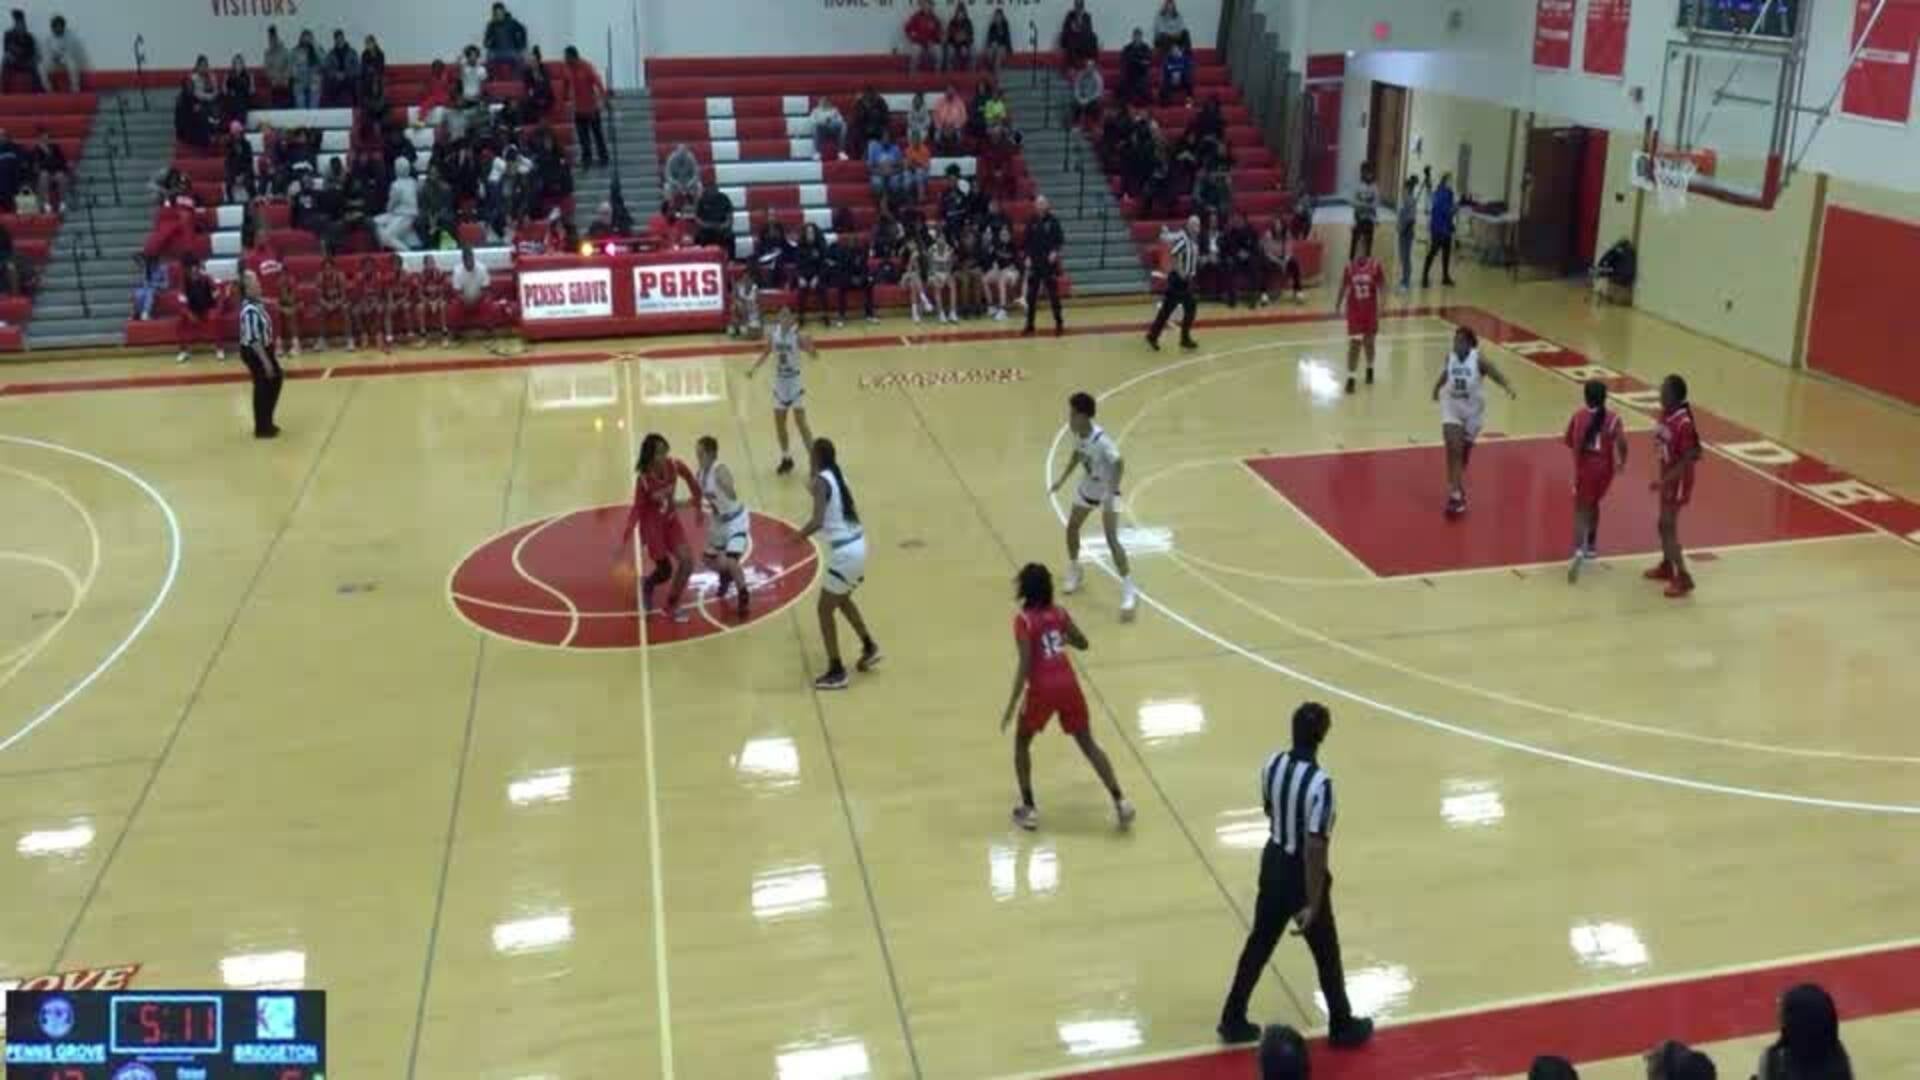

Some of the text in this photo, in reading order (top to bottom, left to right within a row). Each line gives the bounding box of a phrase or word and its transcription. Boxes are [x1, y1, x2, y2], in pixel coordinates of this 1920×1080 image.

[211, 0, 298, 17] VISITORS
[523, 279, 609, 308] PENNS GROVE
[639, 269, 719, 299] PGHS
